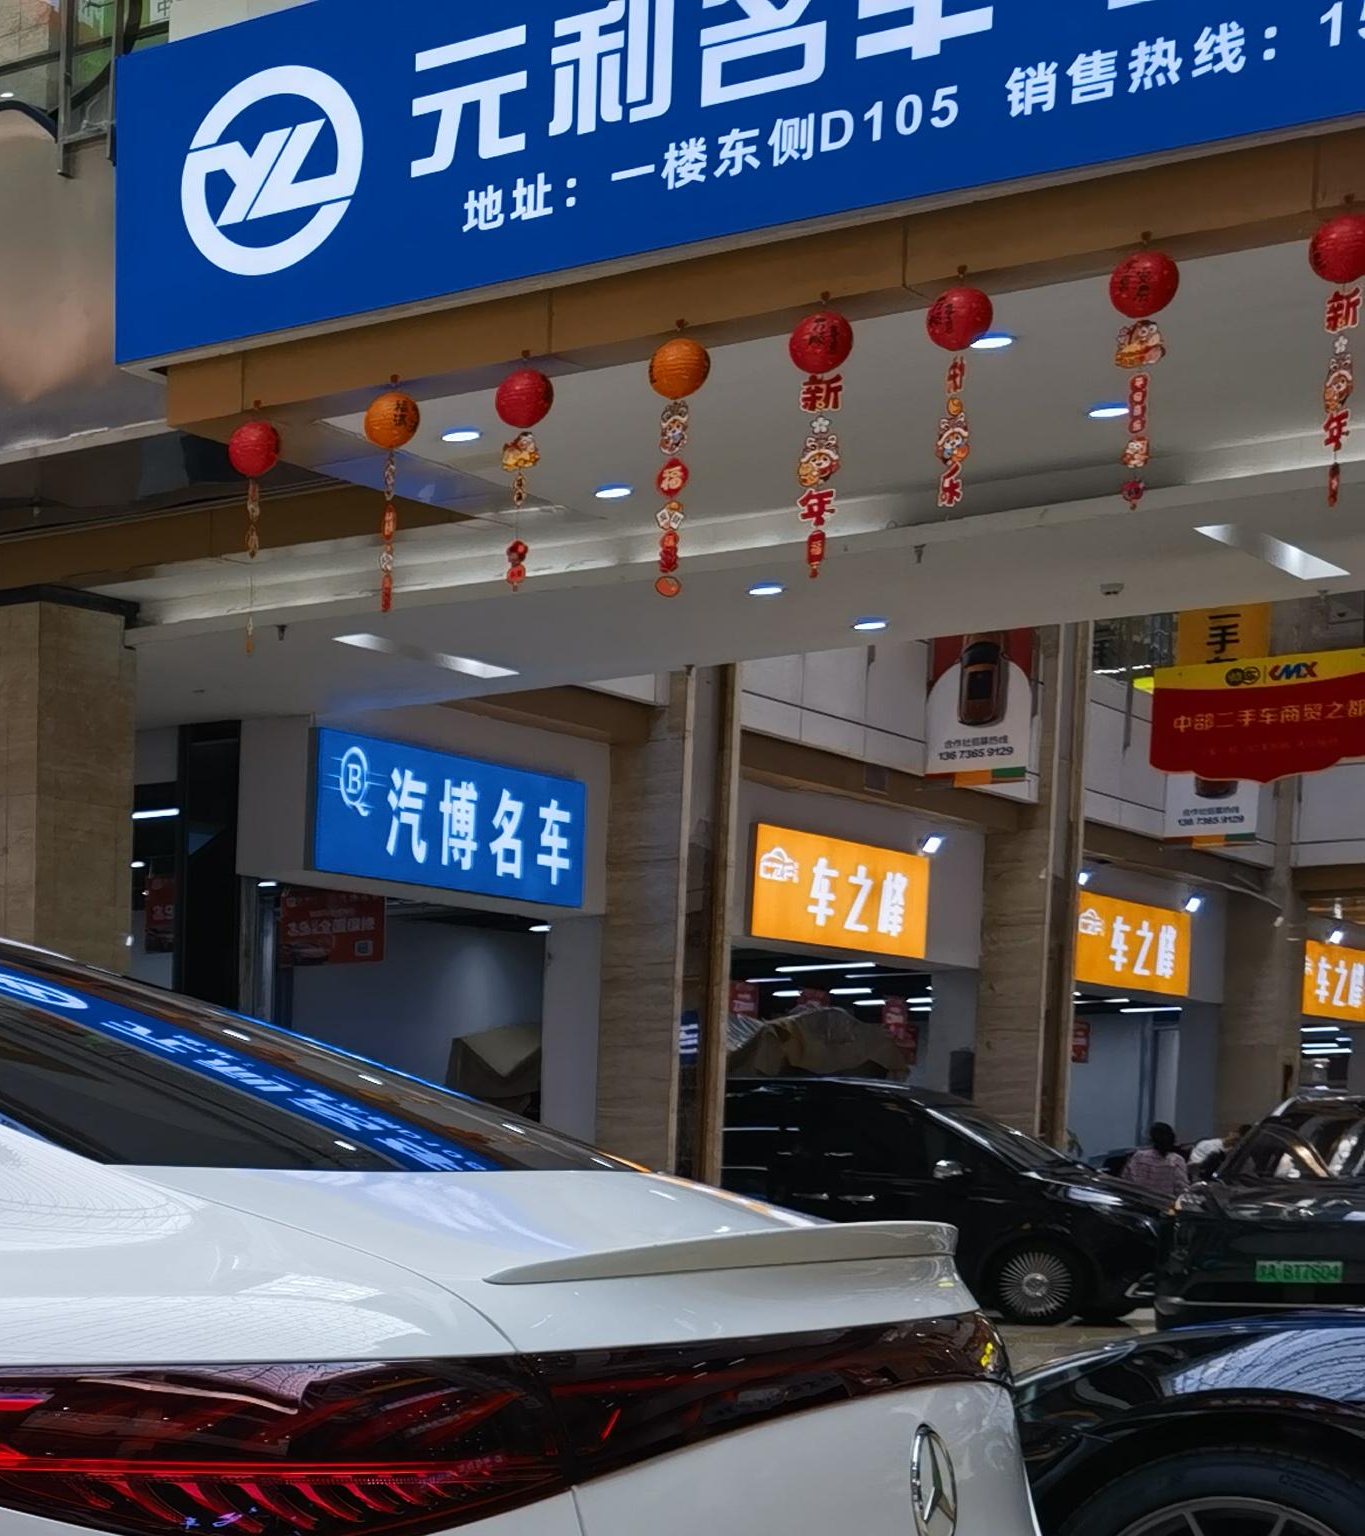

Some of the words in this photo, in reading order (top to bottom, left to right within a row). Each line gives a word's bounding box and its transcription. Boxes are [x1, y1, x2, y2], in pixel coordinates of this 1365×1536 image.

[386, 767, 571, 886] 汽博名车
[807, 856, 907, 936] 车之峰
[1109, 915, 1177, 979] 车之峰
